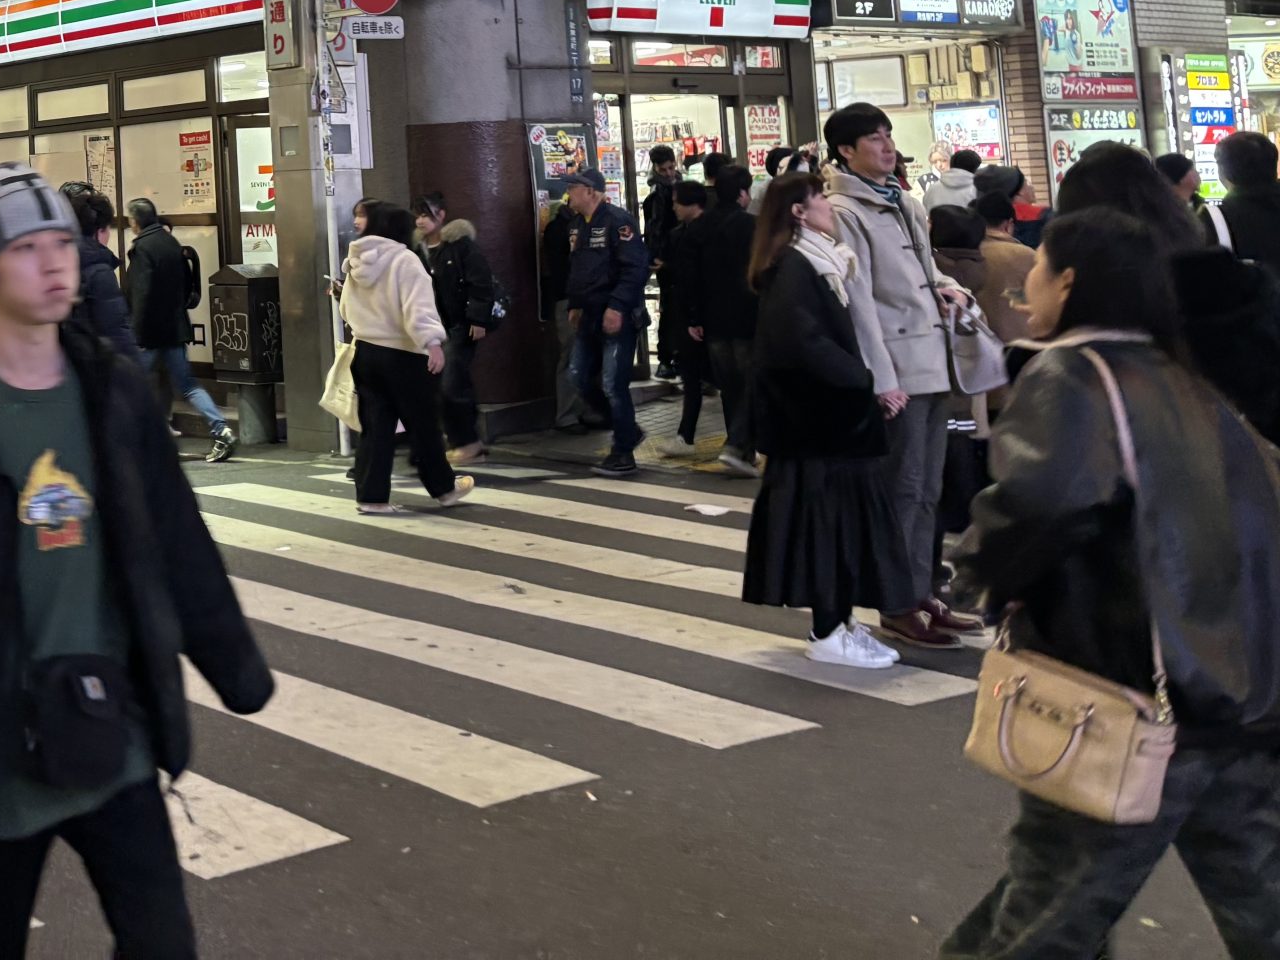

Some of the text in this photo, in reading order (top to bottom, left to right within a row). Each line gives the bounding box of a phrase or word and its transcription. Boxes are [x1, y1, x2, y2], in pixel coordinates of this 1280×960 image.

[855, 1, 874, 15] 2F
[352, 21, 401, 36] 自転車を除く
[748, 105, 781, 118] ATM
[1195, 110, 1227, 124] セントラル
[1051, 113, 1069, 127] 2F
[245, 224, 274, 239] ATM
